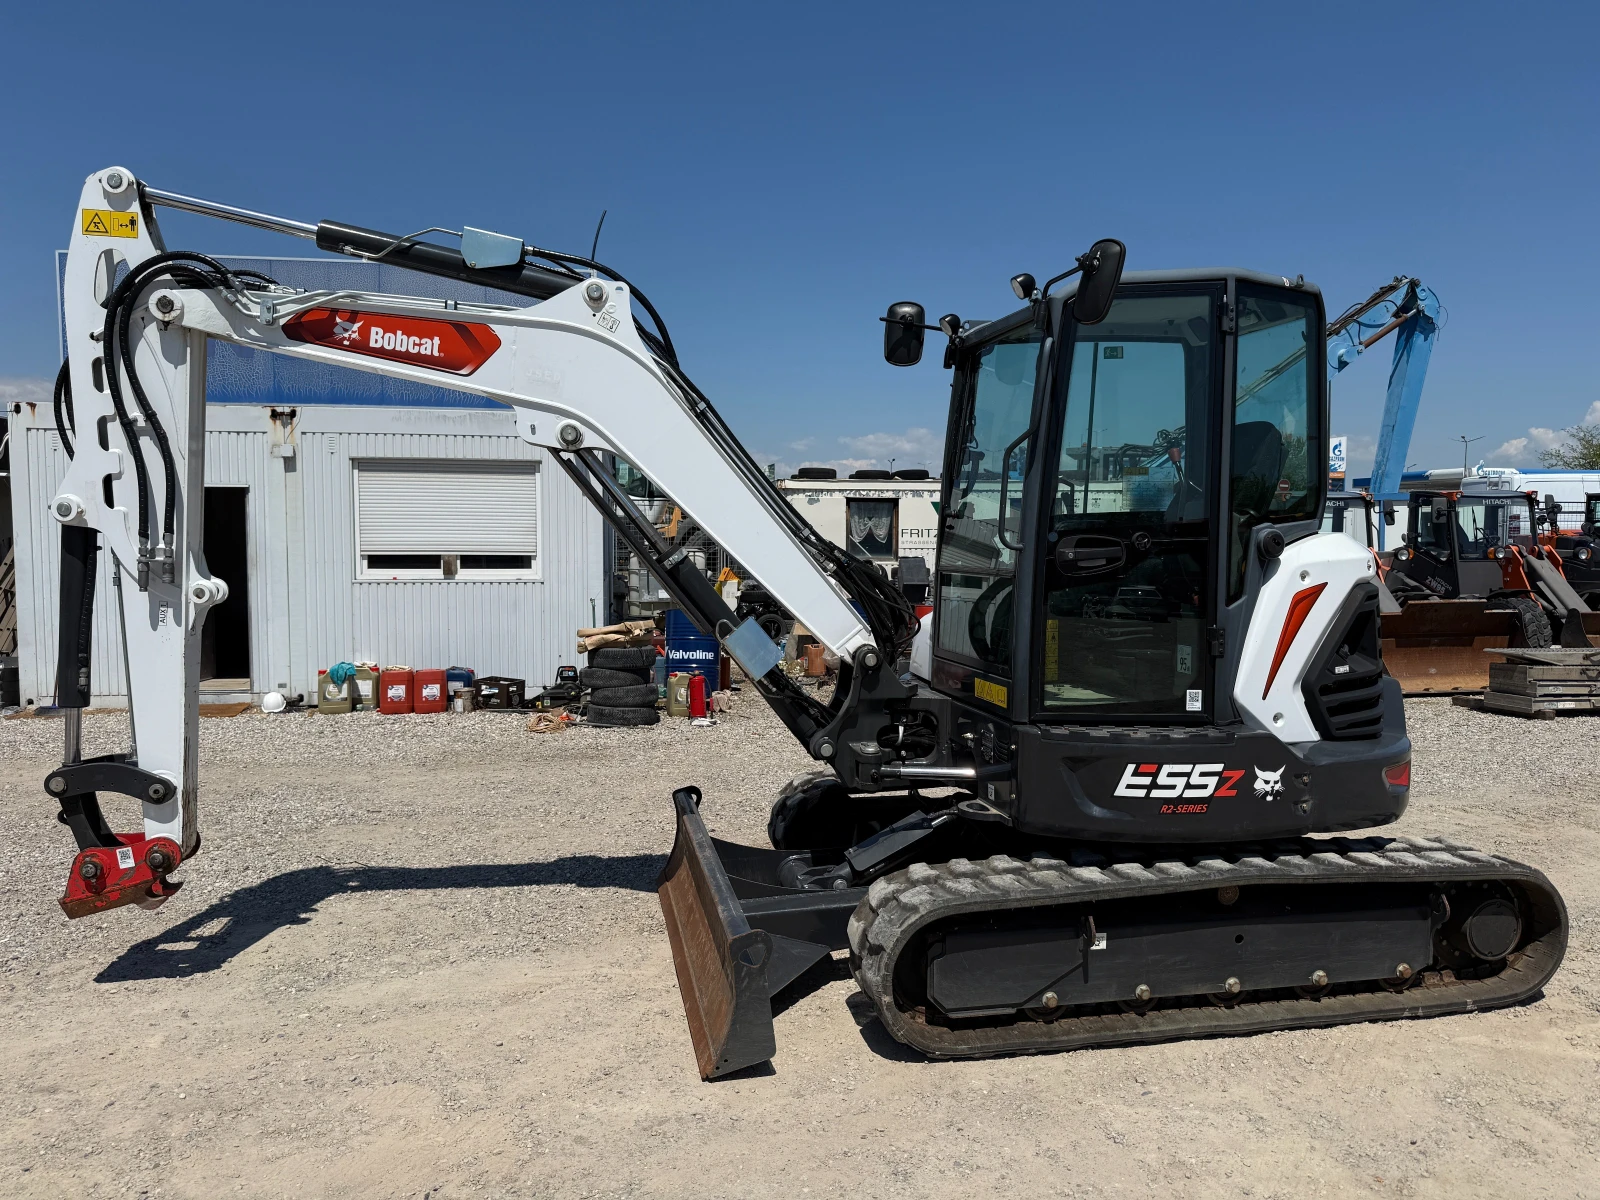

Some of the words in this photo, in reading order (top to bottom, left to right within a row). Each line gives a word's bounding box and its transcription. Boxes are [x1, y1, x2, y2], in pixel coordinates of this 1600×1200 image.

[369, 326, 442, 357] Bobcat
[668, 649, 715, 660] Valvoline
[1160, 804, 1208, 814] R2-SERIES
